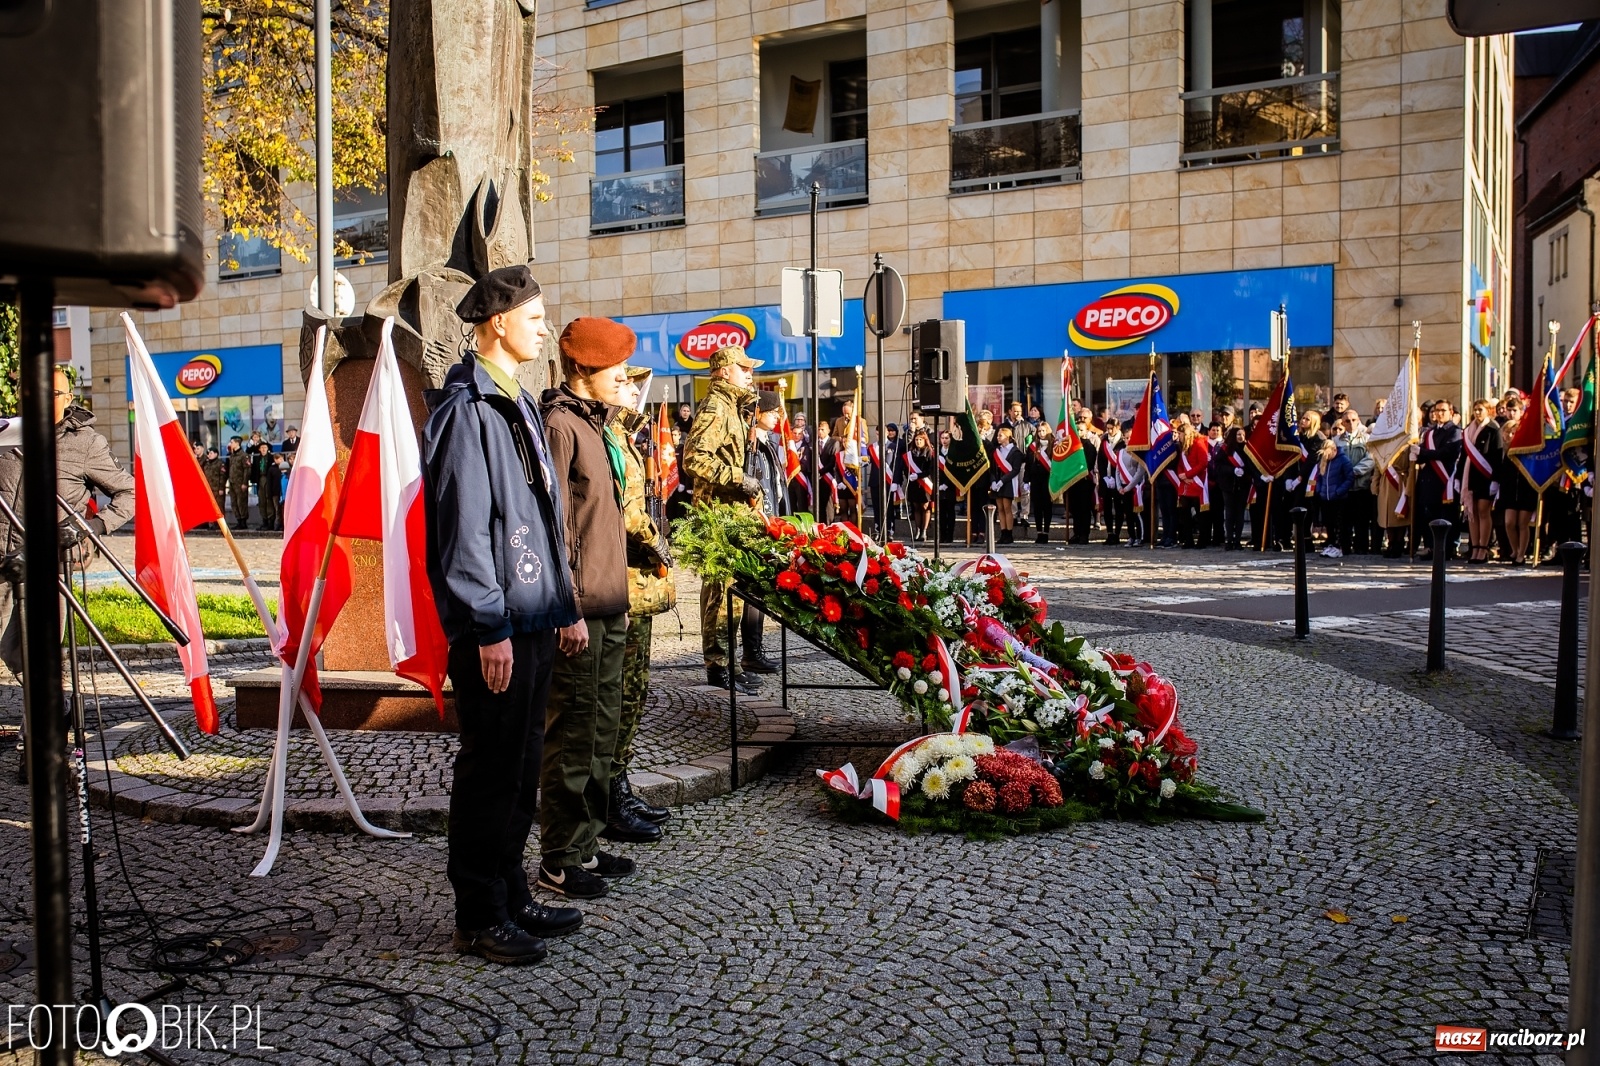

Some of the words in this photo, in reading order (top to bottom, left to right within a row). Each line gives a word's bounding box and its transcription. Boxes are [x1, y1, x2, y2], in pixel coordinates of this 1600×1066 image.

[1084, 304, 1161, 329] PEPCO
[686, 331, 742, 352] PEPCO
[182, 367, 213, 382] PEPCO
